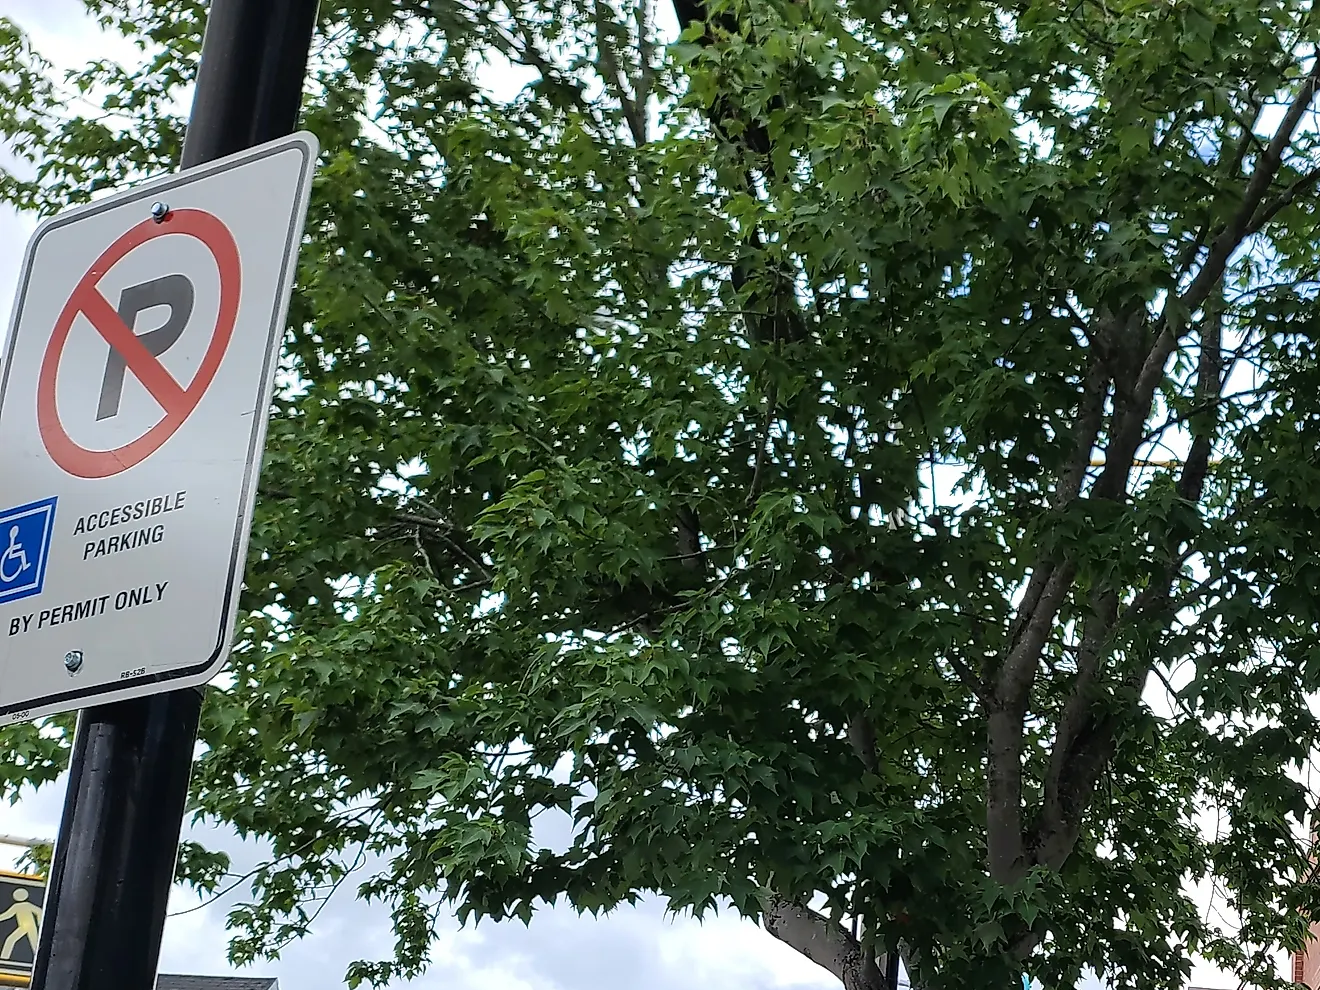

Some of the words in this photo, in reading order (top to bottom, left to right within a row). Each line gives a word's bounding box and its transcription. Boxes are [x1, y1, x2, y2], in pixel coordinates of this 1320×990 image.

[73, 490, 187, 537] ACCESSIBLE
[82, 524, 165, 561] PARKING
[8, 613, 34, 637] BY
[38, 595, 110, 630] PERMIT
[115, 581, 169, 612] ONLY
